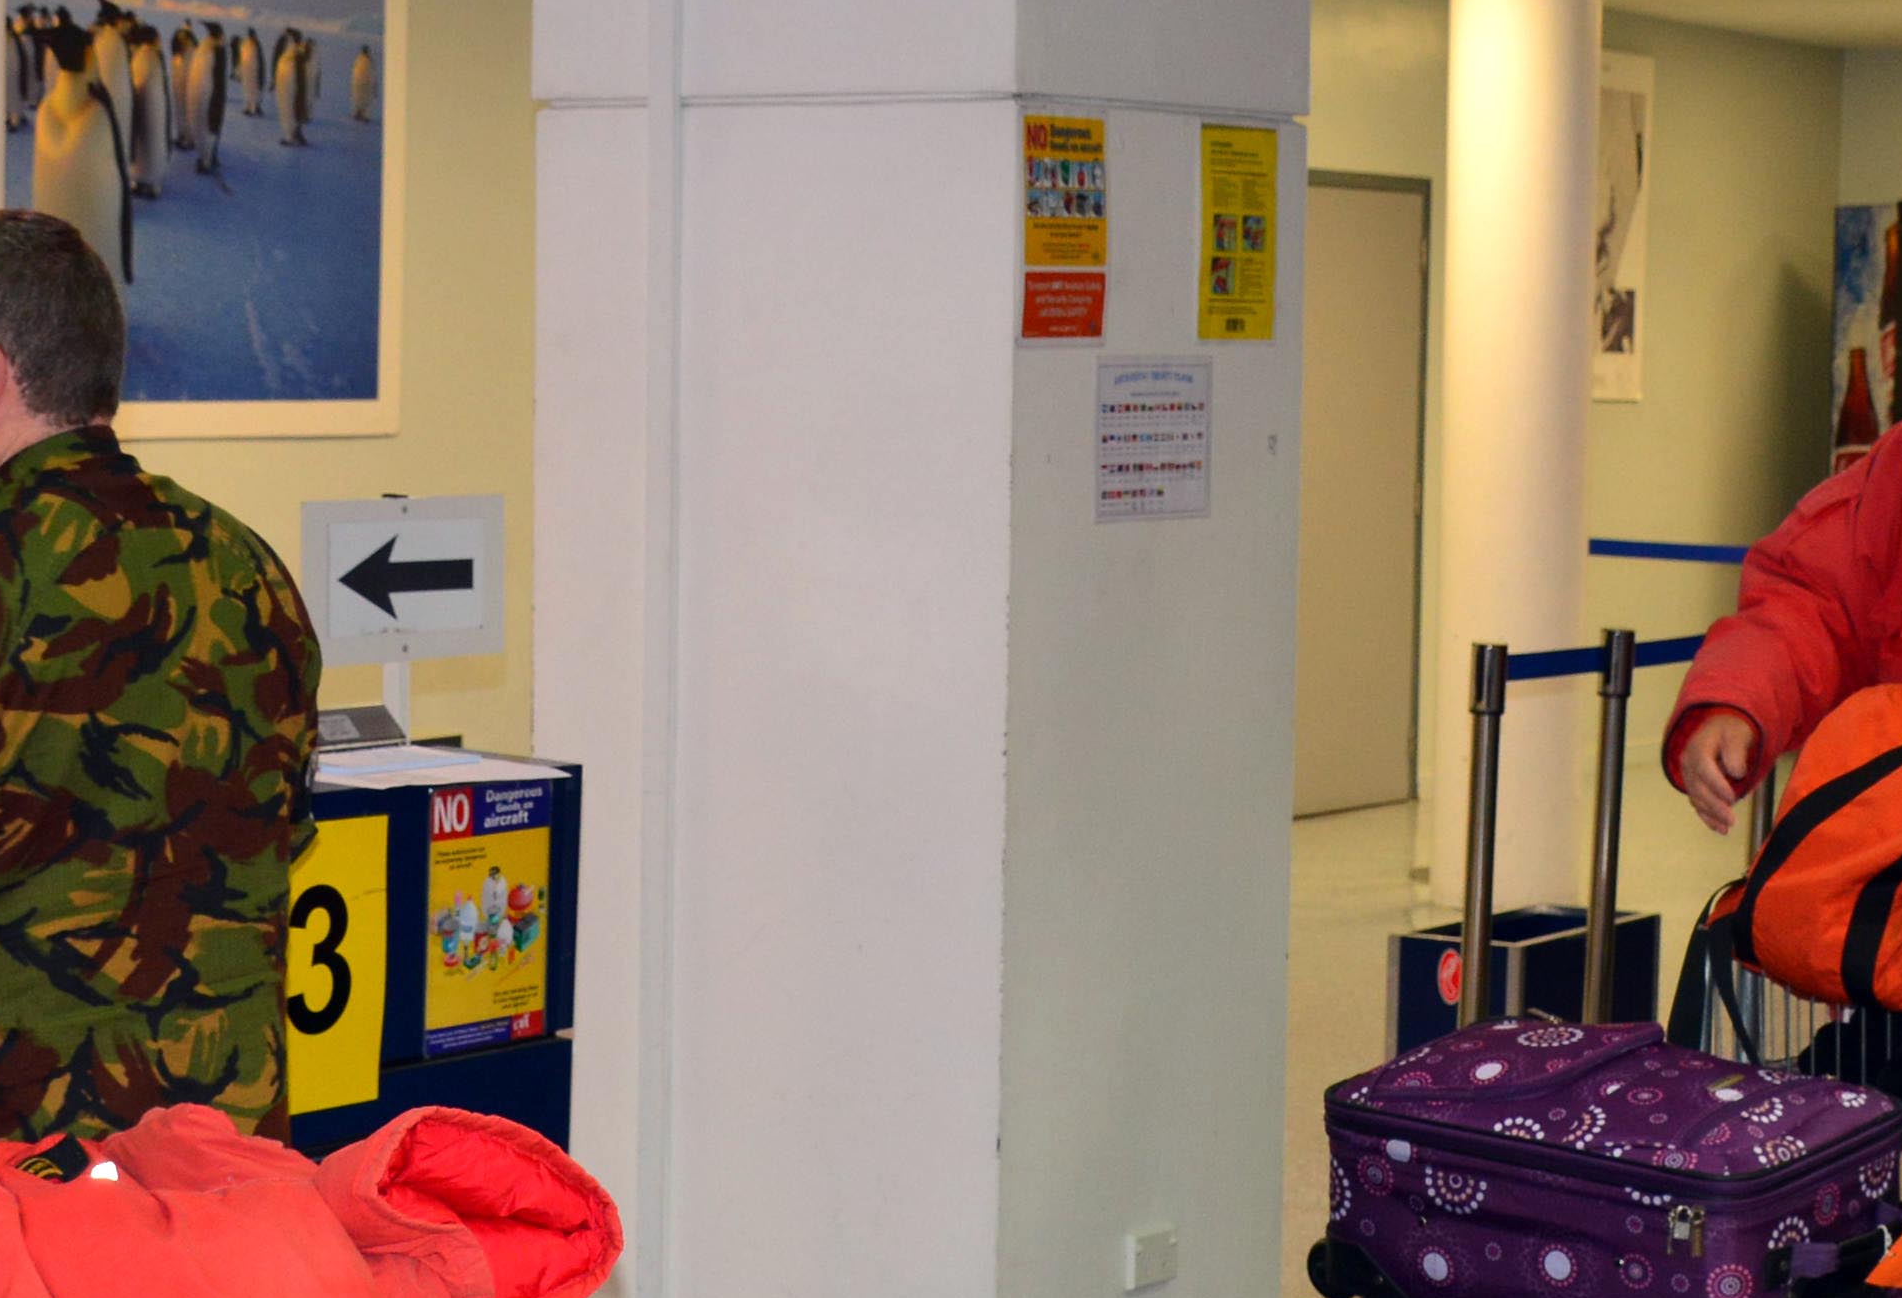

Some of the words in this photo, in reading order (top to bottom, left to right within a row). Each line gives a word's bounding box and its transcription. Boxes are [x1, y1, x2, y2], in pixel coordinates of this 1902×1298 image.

[485, 787, 543, 803] Dangerous
[432, 792, 470, 834] NO
[483, 810, 529, 828] aircraft
[286, 884, 352, 1035] 3
